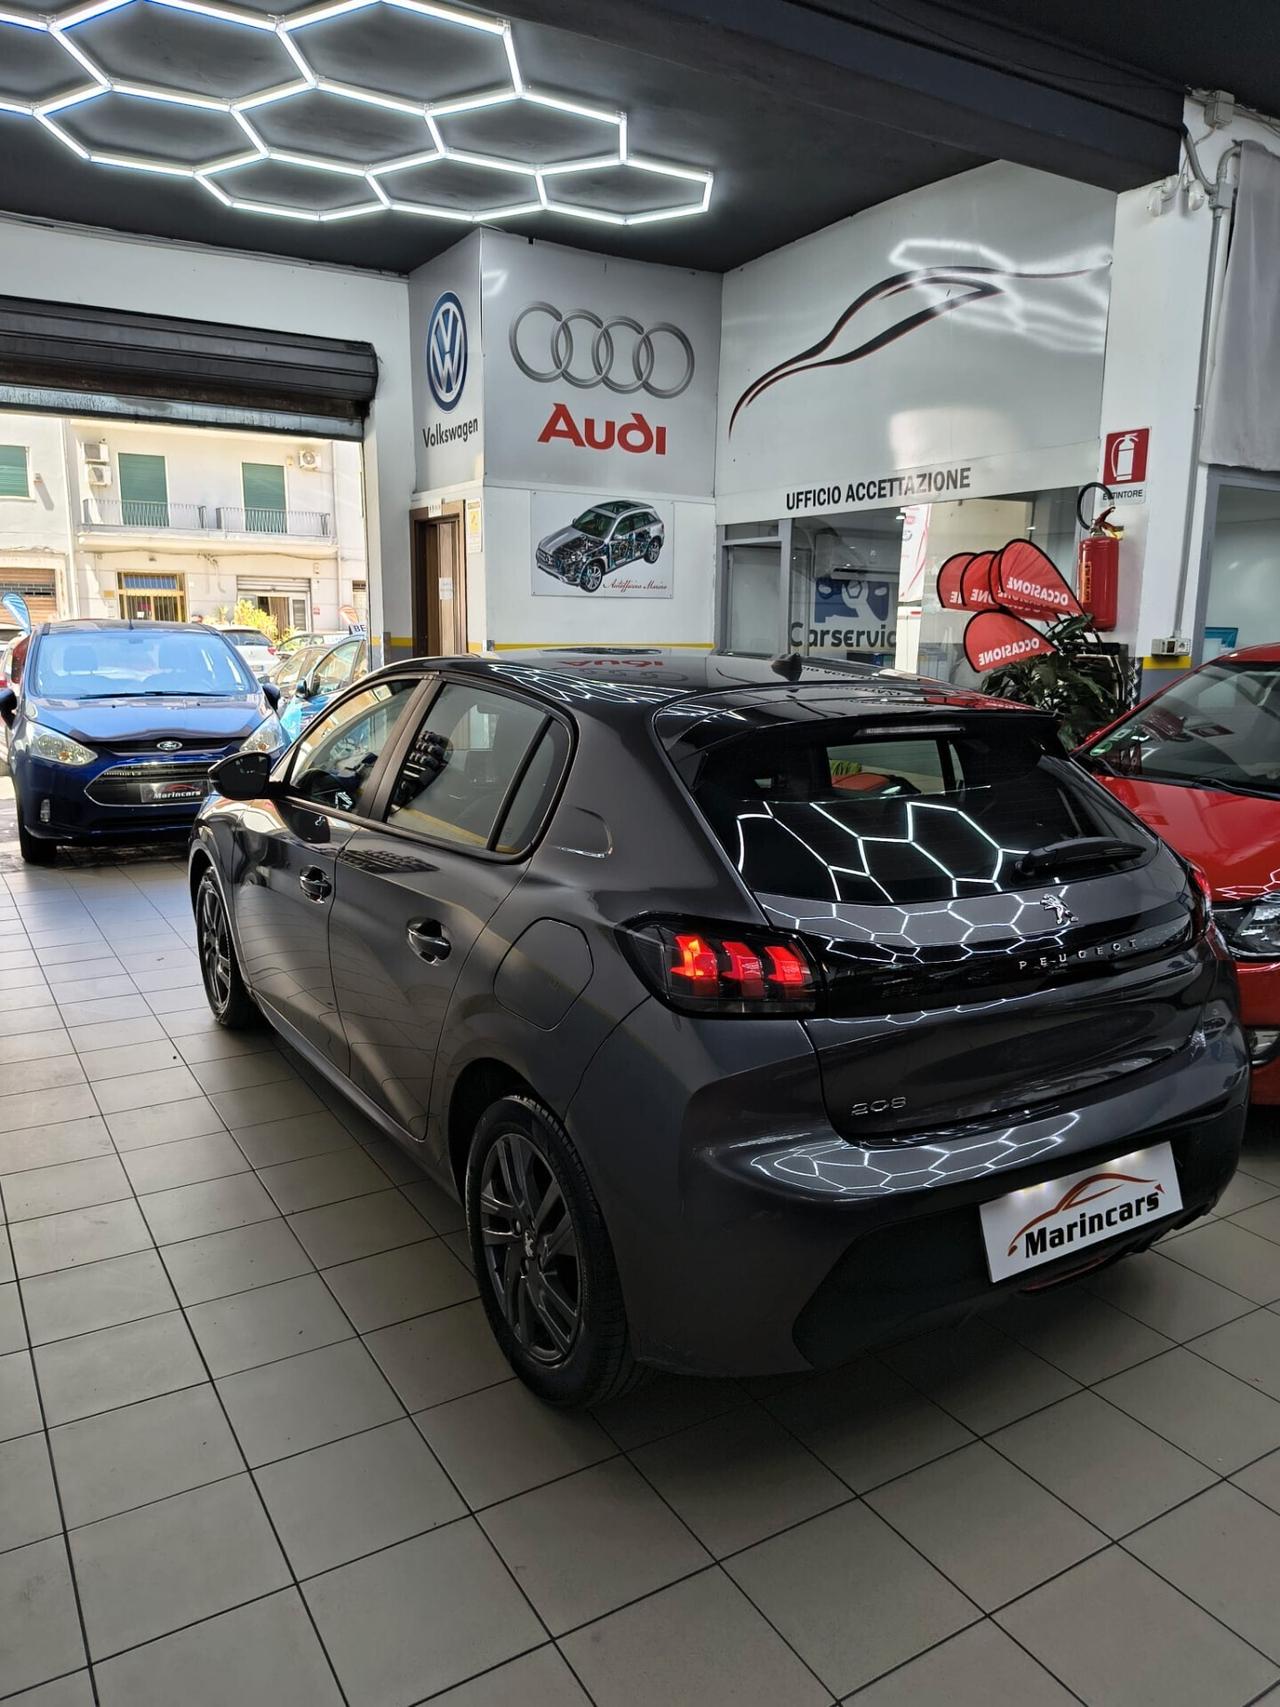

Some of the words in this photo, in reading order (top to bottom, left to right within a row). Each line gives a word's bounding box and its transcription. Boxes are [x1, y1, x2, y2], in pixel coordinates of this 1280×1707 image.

[422, 418, 478, 448] Volkswagen
[537, 403, 667, 455] Audi
[786, 485, 842, 511] UFFICIO
[845, 467, 972, 503] ACCETTAZIONE
[1102, 489, 1143, 500] ETINTORE
[153, 790, 201, 799] Marincars
[1018, 940, 1137, 970] PEUGEOT
[851, 1096, 906, 1116] 208
[1025, 1192, 1159, 1258] Marincars
